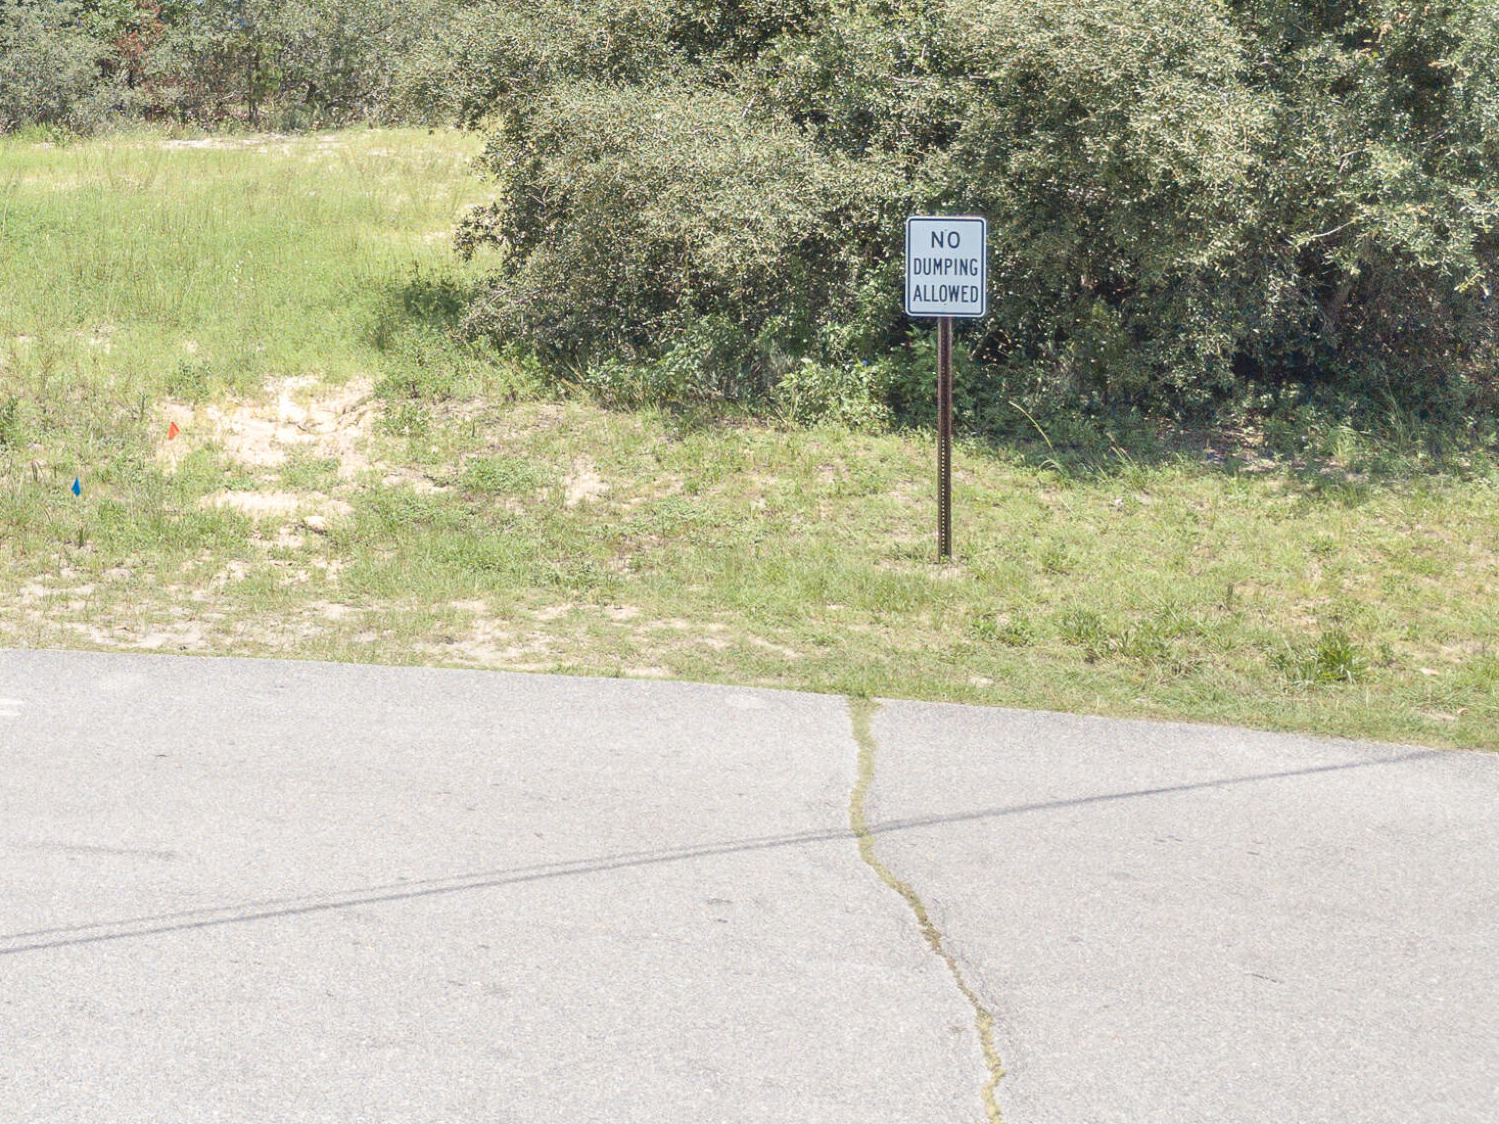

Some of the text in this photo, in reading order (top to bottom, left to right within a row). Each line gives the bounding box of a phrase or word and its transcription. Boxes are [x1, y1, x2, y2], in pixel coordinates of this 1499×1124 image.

[931, 230, 961, 249] NO
[913, 257, 978, 277] DUMPING
[912, 284, 979, 303] ALLOWED
